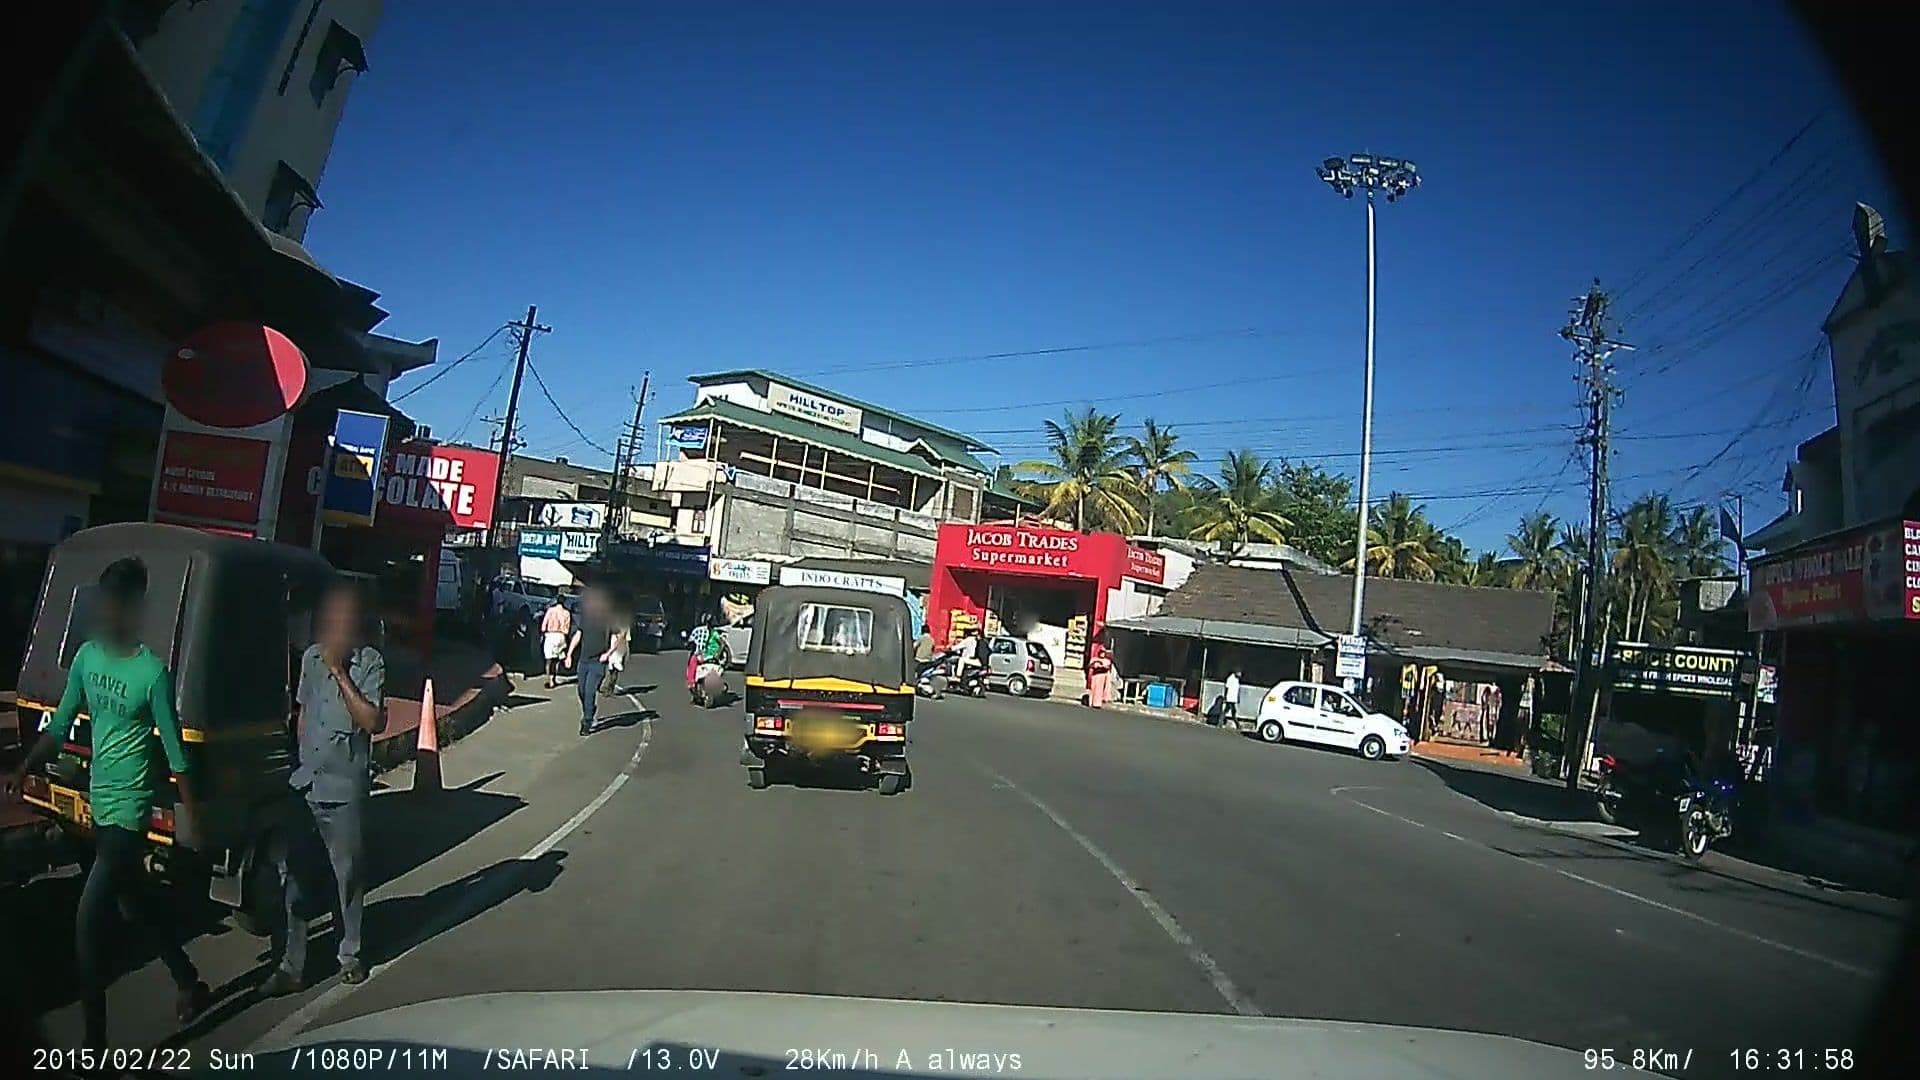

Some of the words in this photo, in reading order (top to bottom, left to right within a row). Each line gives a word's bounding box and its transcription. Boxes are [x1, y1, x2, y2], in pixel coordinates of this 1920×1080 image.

[789, 393, 845, 417] HILLTOP
[394, 453, 465, 483] MADE
[306, 463, 477, 517] COLATE
[967, 528, 1012, 547] JACOB
[1016, 530, 1078, 551] TRADES
[971, 547, 1069, 568] Supermarket
[801, 571, 831, 584] INDO
[833, 574, 884, 589] CRAFTS
